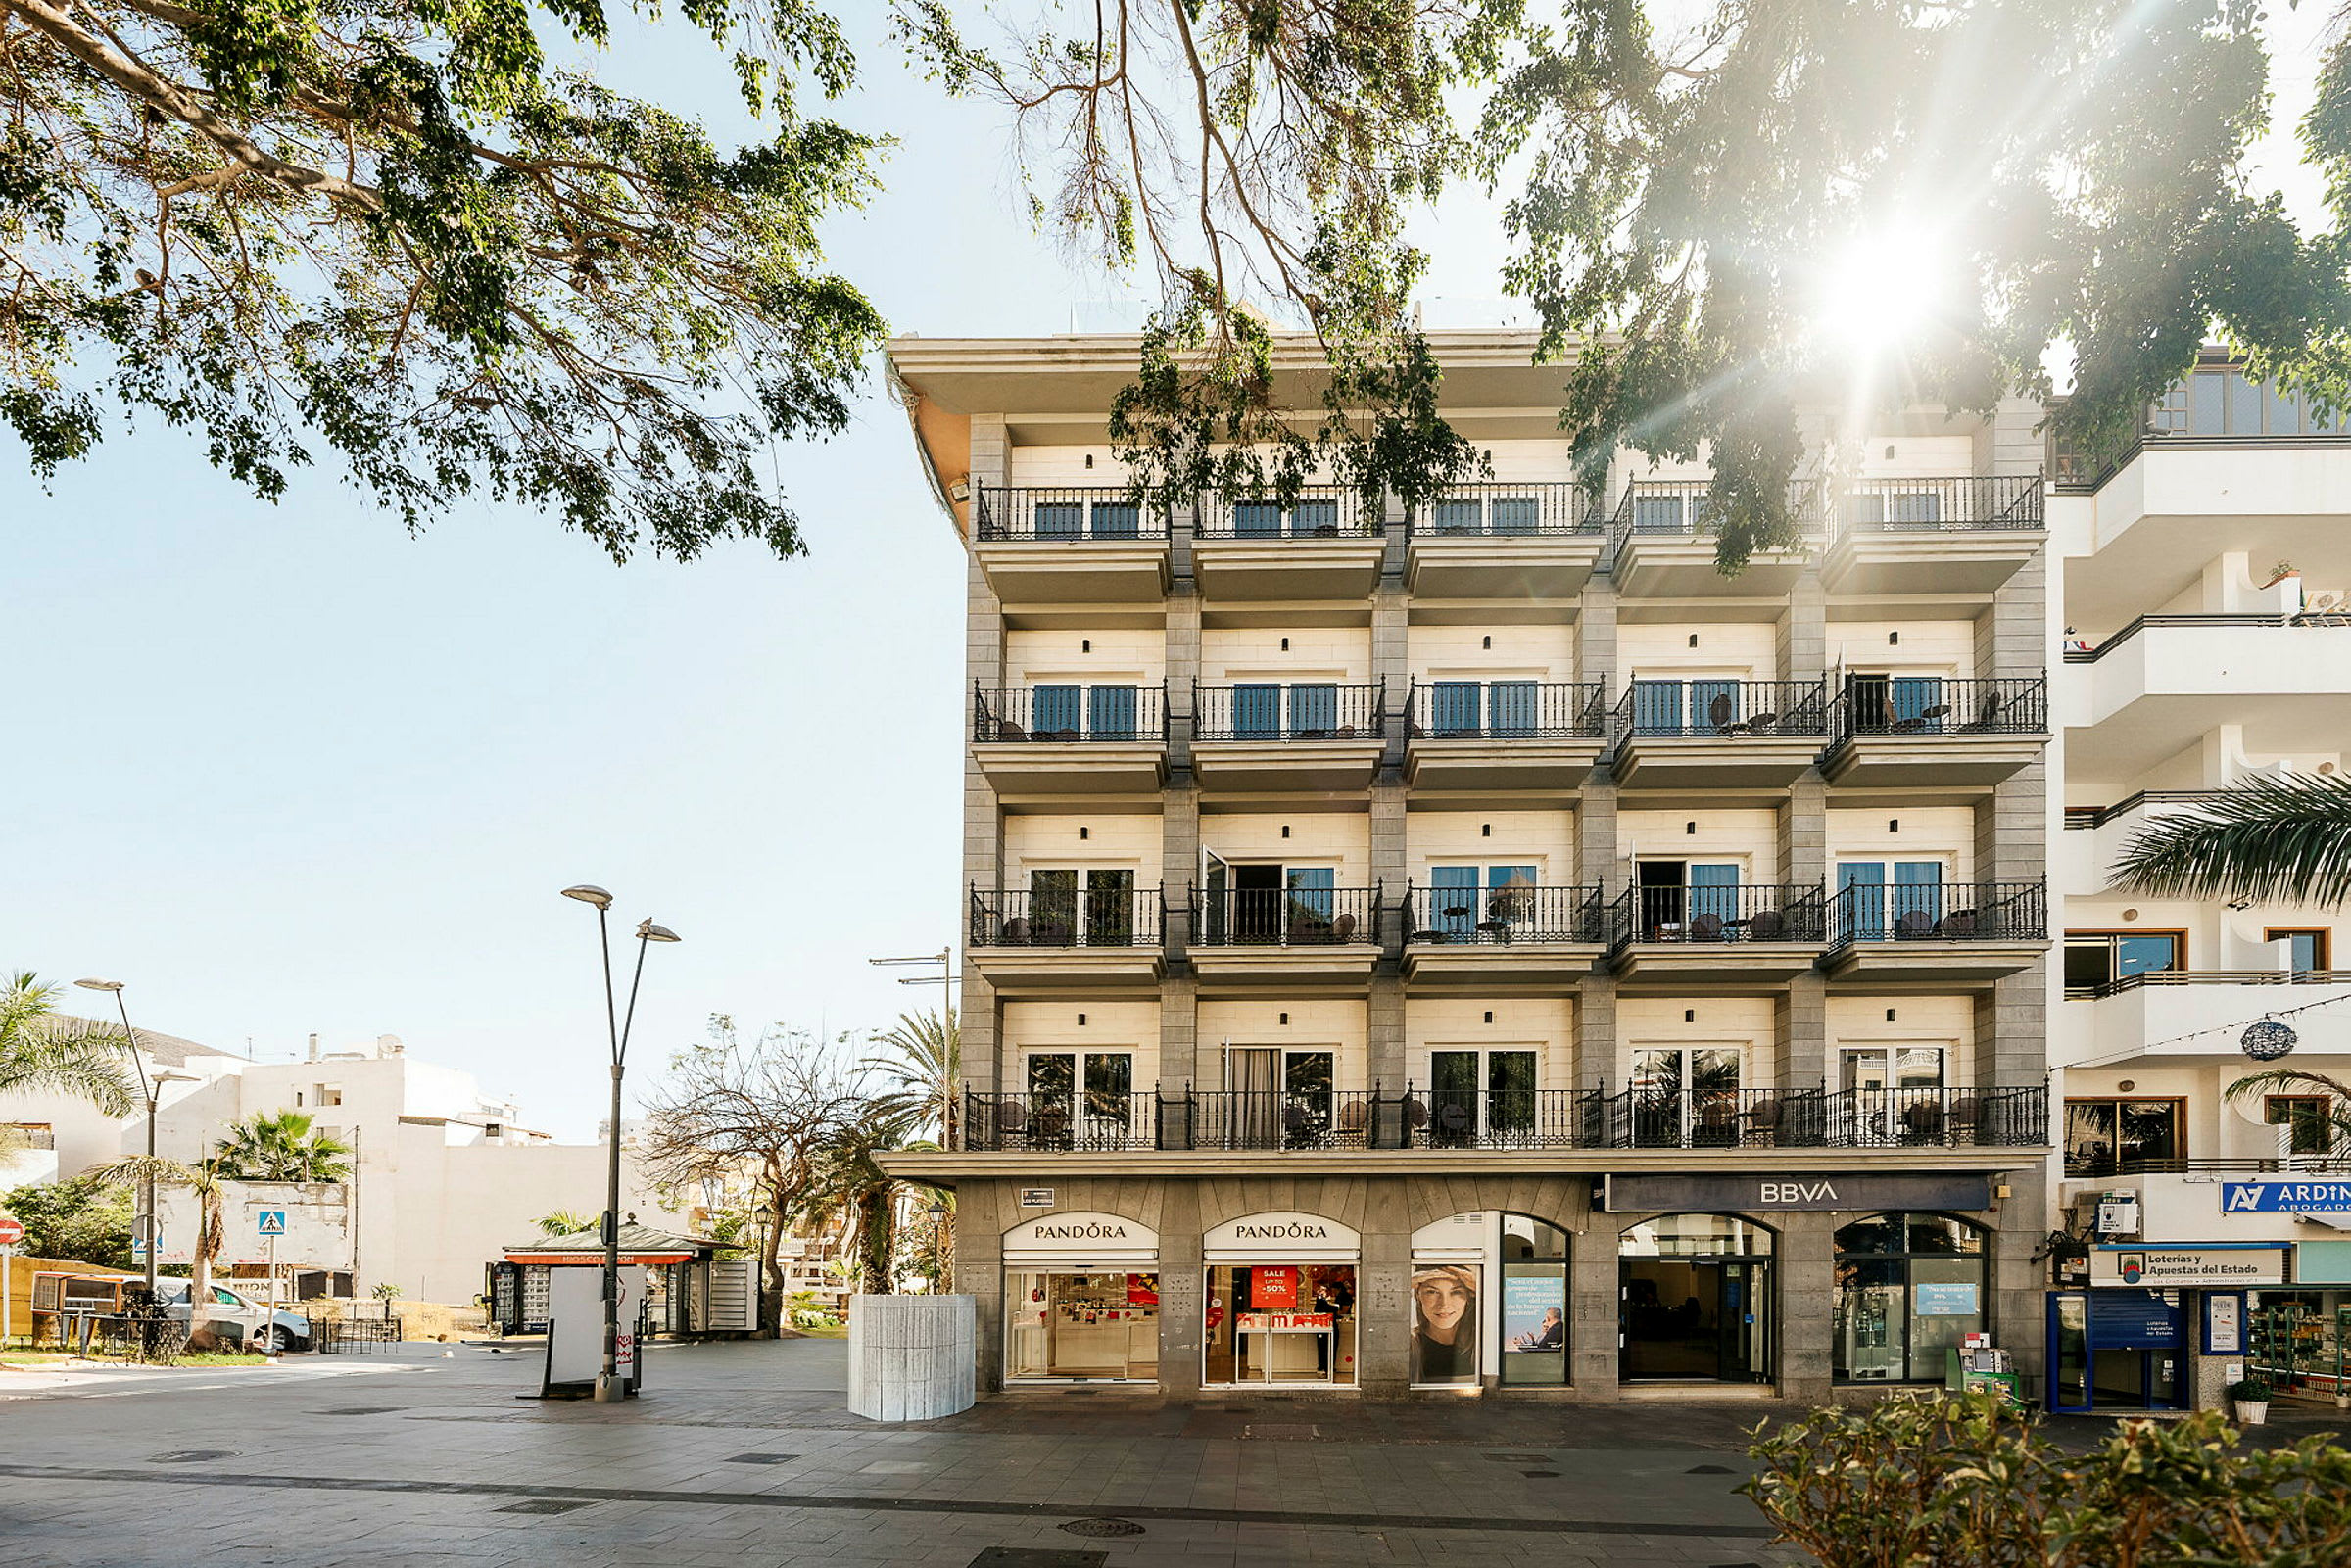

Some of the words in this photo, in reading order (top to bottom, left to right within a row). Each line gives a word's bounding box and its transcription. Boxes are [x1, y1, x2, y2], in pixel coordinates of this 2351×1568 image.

[1760, 1180, 1838, 1203] BBVA
[1035, 1222, 1126, 1238] PANDORA
[1236, 1222, 1326, 1238] PANDORA
[2148, 1255, 2192, 1263] Loterías
[2194, 1256, 2201, 1264] y
[2149, 1266, 2199, 1276] Apuestas
[2201, 1265, 2219, 1274] del
[2221, 1264, 2258, 1274] Estado
